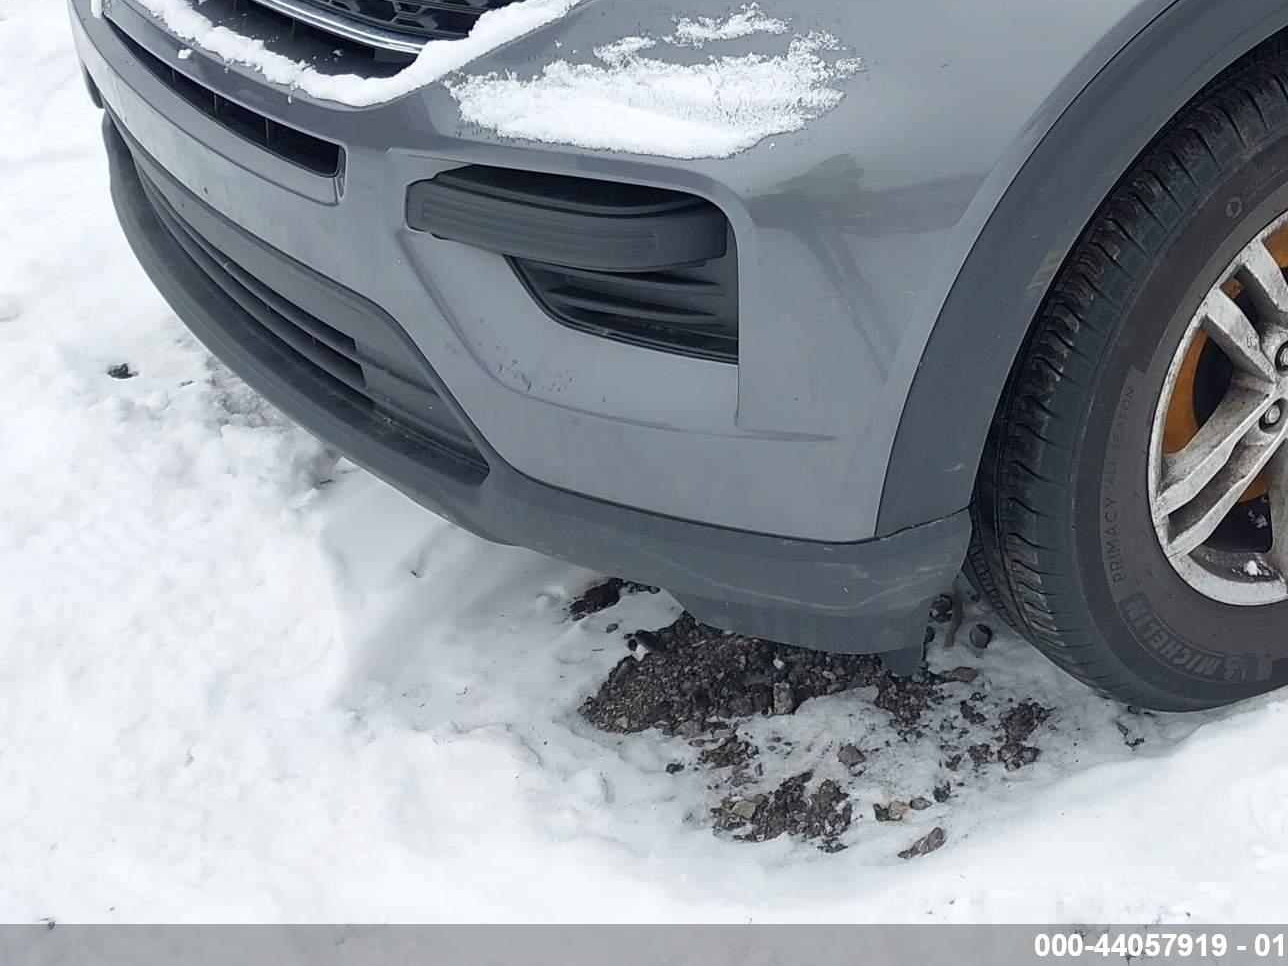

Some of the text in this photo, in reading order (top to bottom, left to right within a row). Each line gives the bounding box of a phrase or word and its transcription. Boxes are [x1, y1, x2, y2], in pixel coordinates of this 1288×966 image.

[1111, 386, 1136, 452] SEASON
[1104, 496, 1126, 585] PRIMACY
[1124, 598, 1222, 677] MICHELIN
